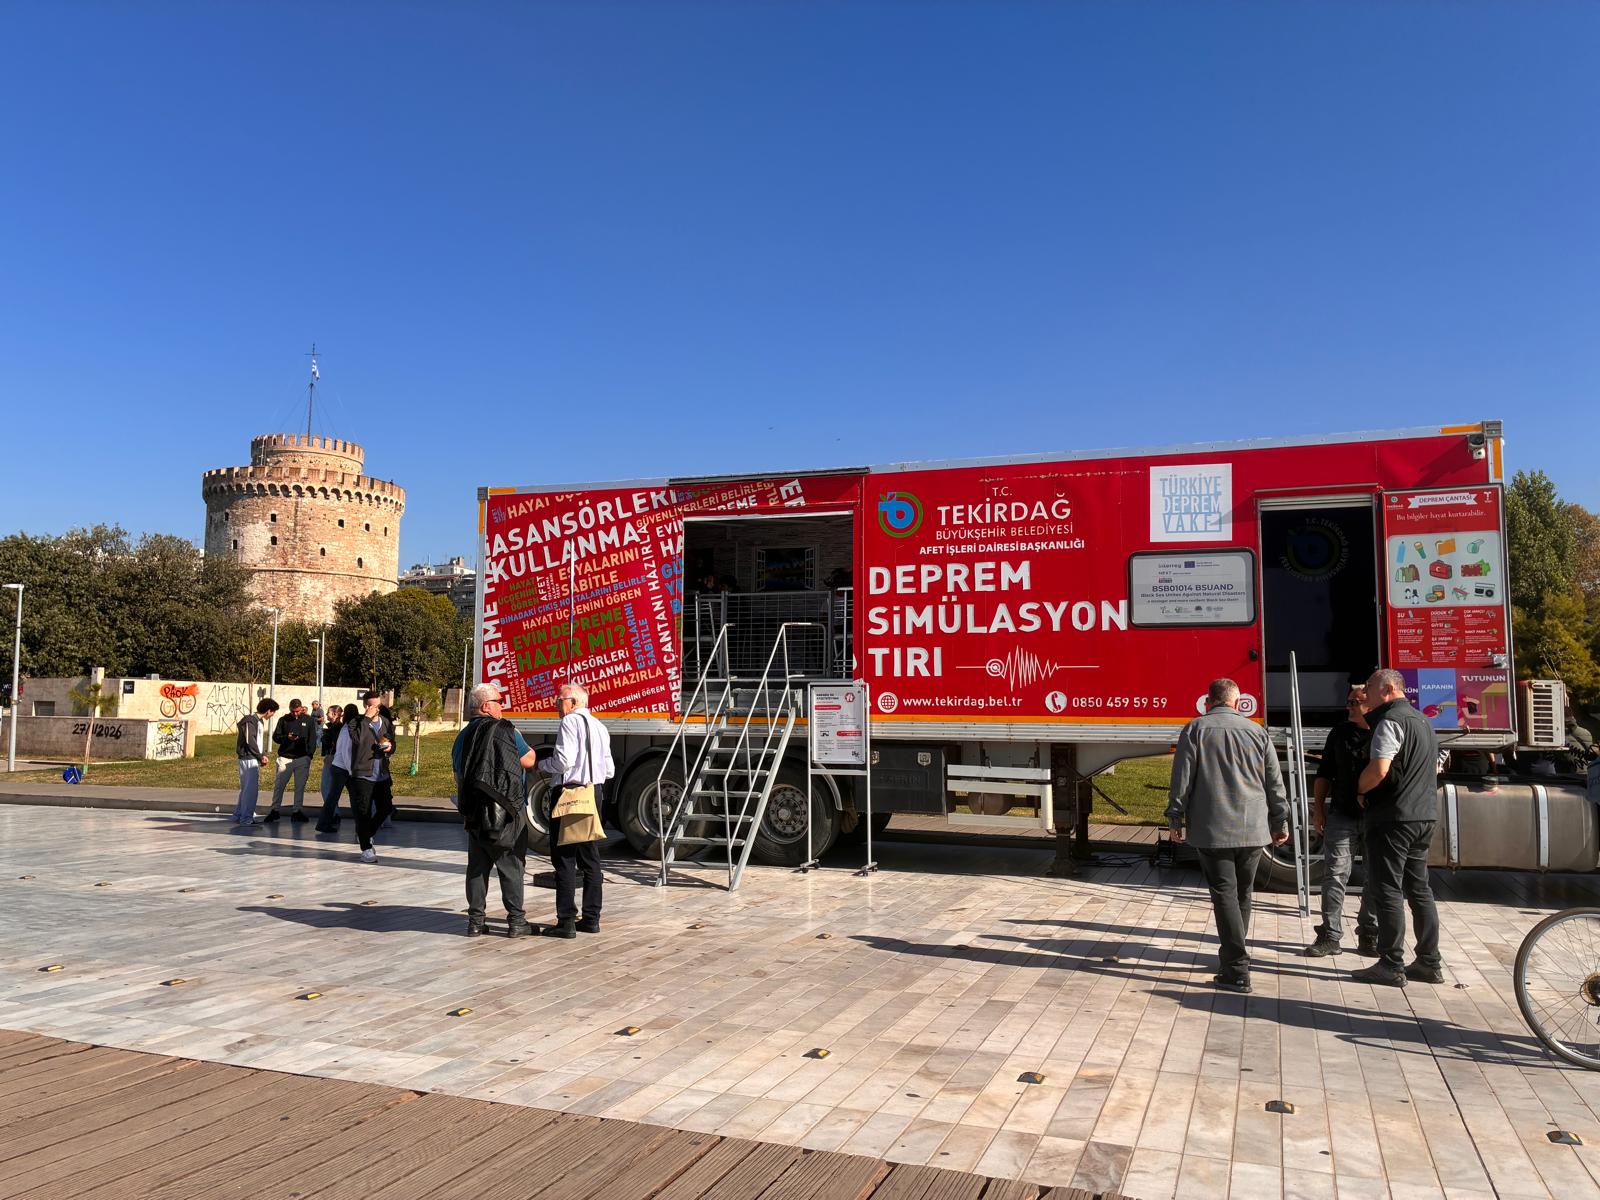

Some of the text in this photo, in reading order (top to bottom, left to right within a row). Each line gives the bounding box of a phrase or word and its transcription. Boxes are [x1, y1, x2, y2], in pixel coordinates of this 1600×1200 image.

[992, 486, 1012, 497] T.C.
[1160, 473, 1222, 496] TÜRKİYE
[937, 492, 1071, 526] TEKİRDAĞ
[1164, 495, 1221, 513] DEPREM
[936, 521, 1073, 541] BÜYÜKŞEHİR BELEDİYESİ
[491, 522, 640, 583] KULLANMA
[637, 524, 660, 591] HAZIRLA
[919, 538, 1085, 556] AFET İŞLERİ DAİRESİ BAŞKANLIĞI
[537, 576, 548, 601] AFET
[869, 560, 1031, 595] DEPREM
[1195, 583, 1234, 591] BSUAND
[523, 613, 553, 630] HAYAT
[607, 587, 642, 606] ÖĞREN
[551, 607, 623, 639] DEPREME
[517, 625, 626, 672] HAZIR MI?
[868, 646, 942, 677] TIRI
[526, 670, 551, 687] AFET
[571, 661, 632, 687] KULLANMA
[614, 665, 663, 689] HAZIRLA
[903, 696, 1023, 709] www.tekirdag.bel.tr
[1072, 697, 1167, 708] 0850 459 59 59
